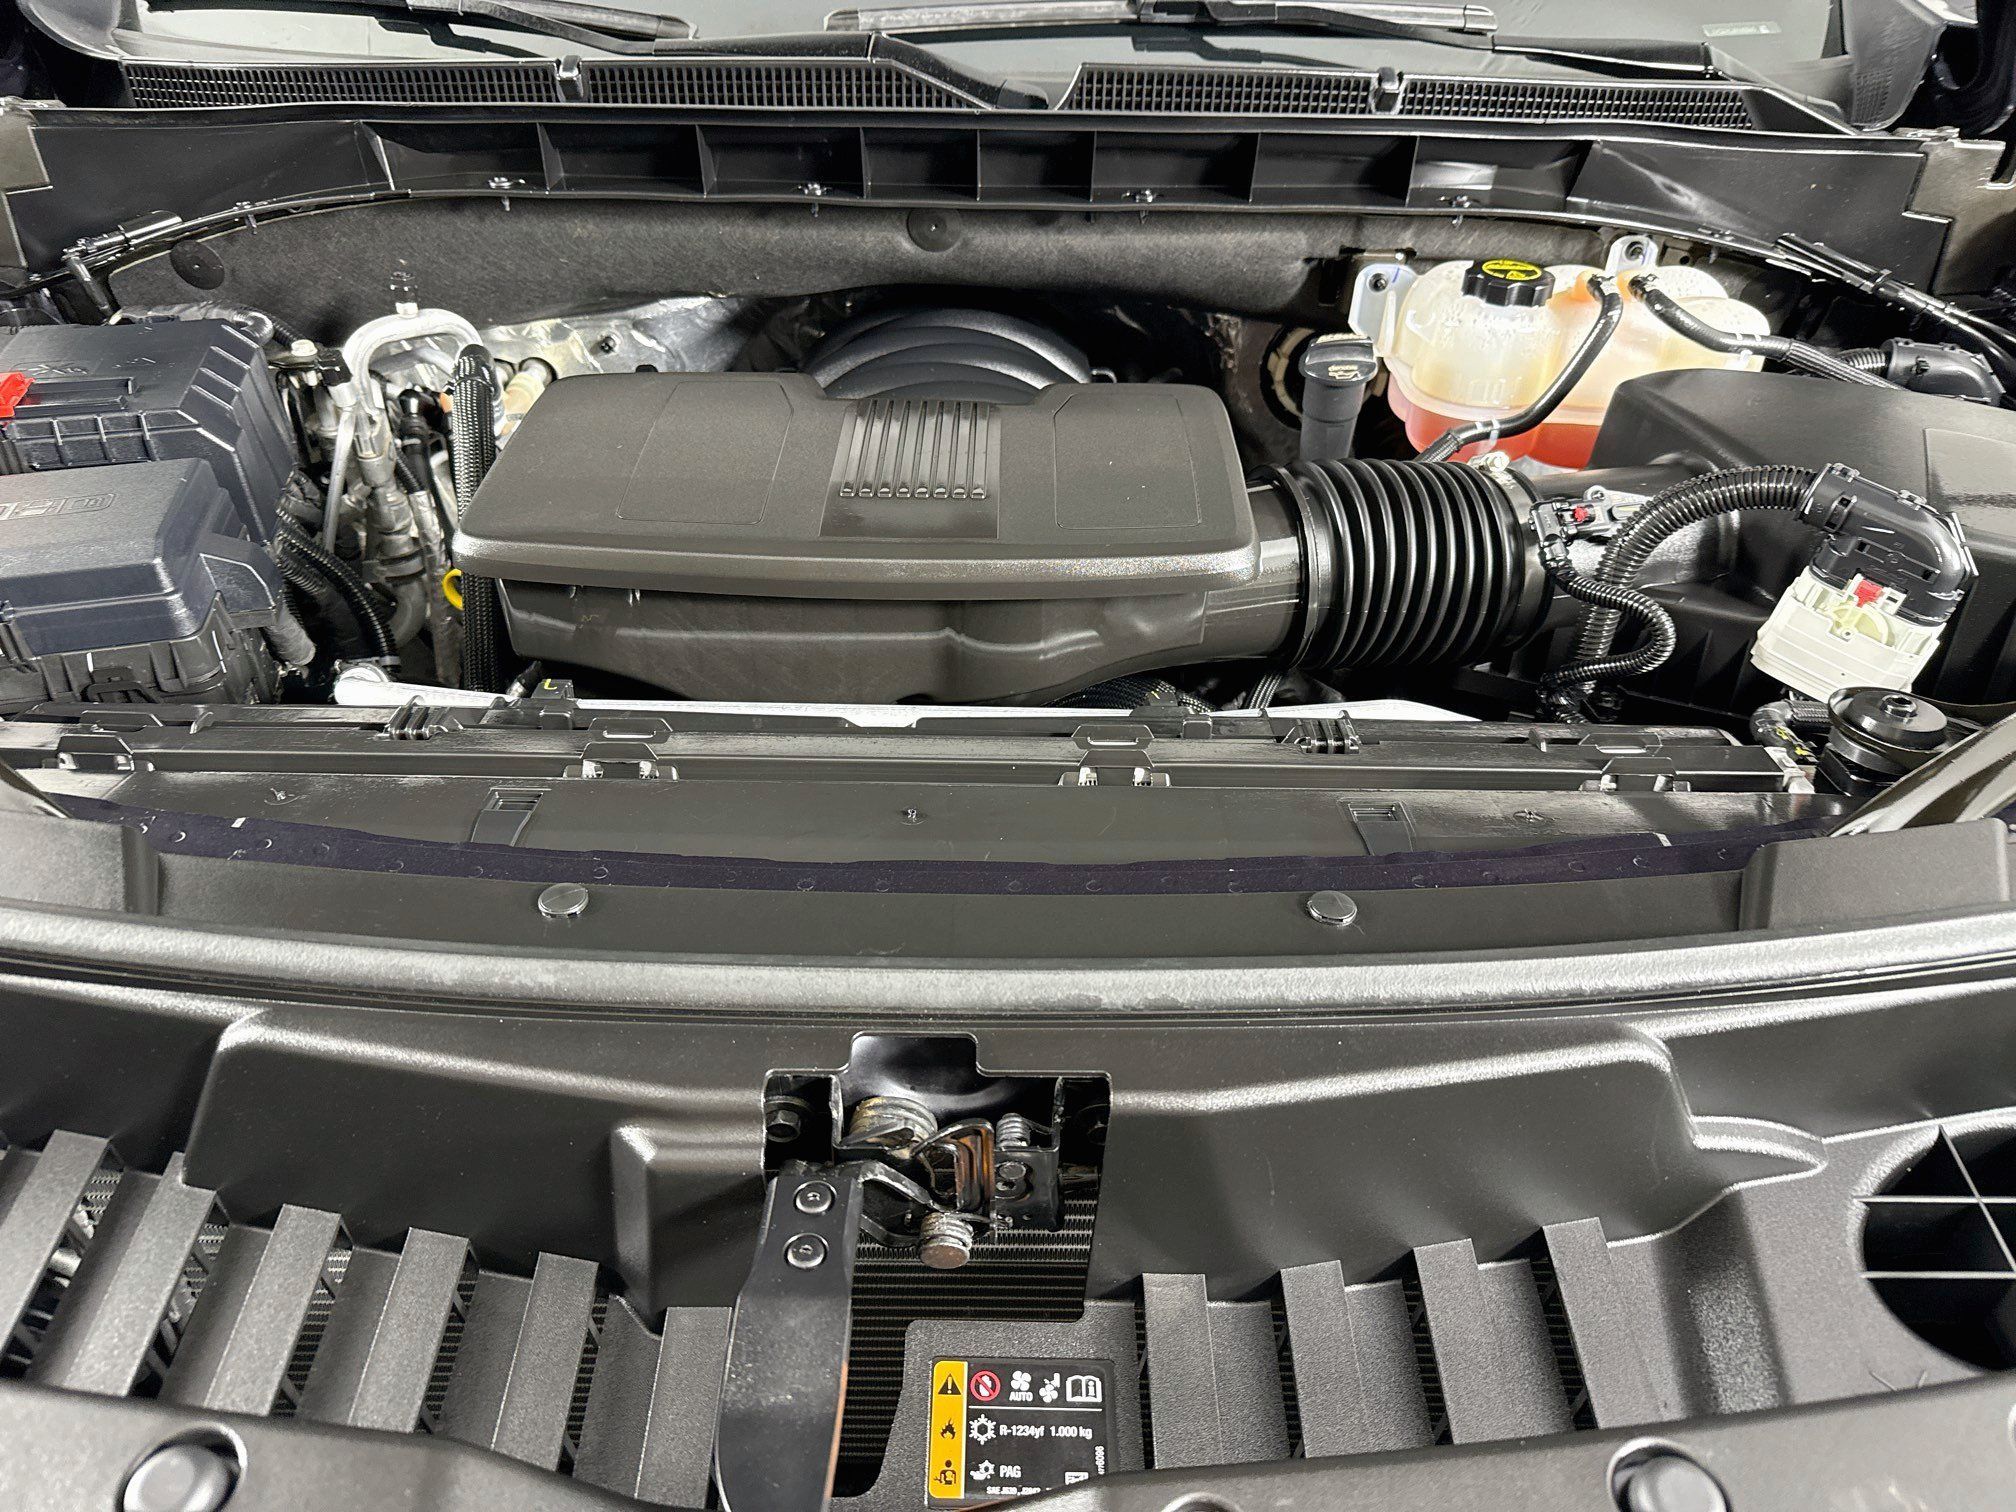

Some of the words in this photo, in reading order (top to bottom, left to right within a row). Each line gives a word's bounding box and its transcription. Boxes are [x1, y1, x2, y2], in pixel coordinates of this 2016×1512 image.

[1009, 1391, 1034, 1402] AUTO
[999, 1425, 1044, 1440] R-1234yf
[1049, 1426, 1077, 1438] 1.000
[1078, 1426, 1093, 1440] kg
[1000, 1464, 1021, 1479] PAG
